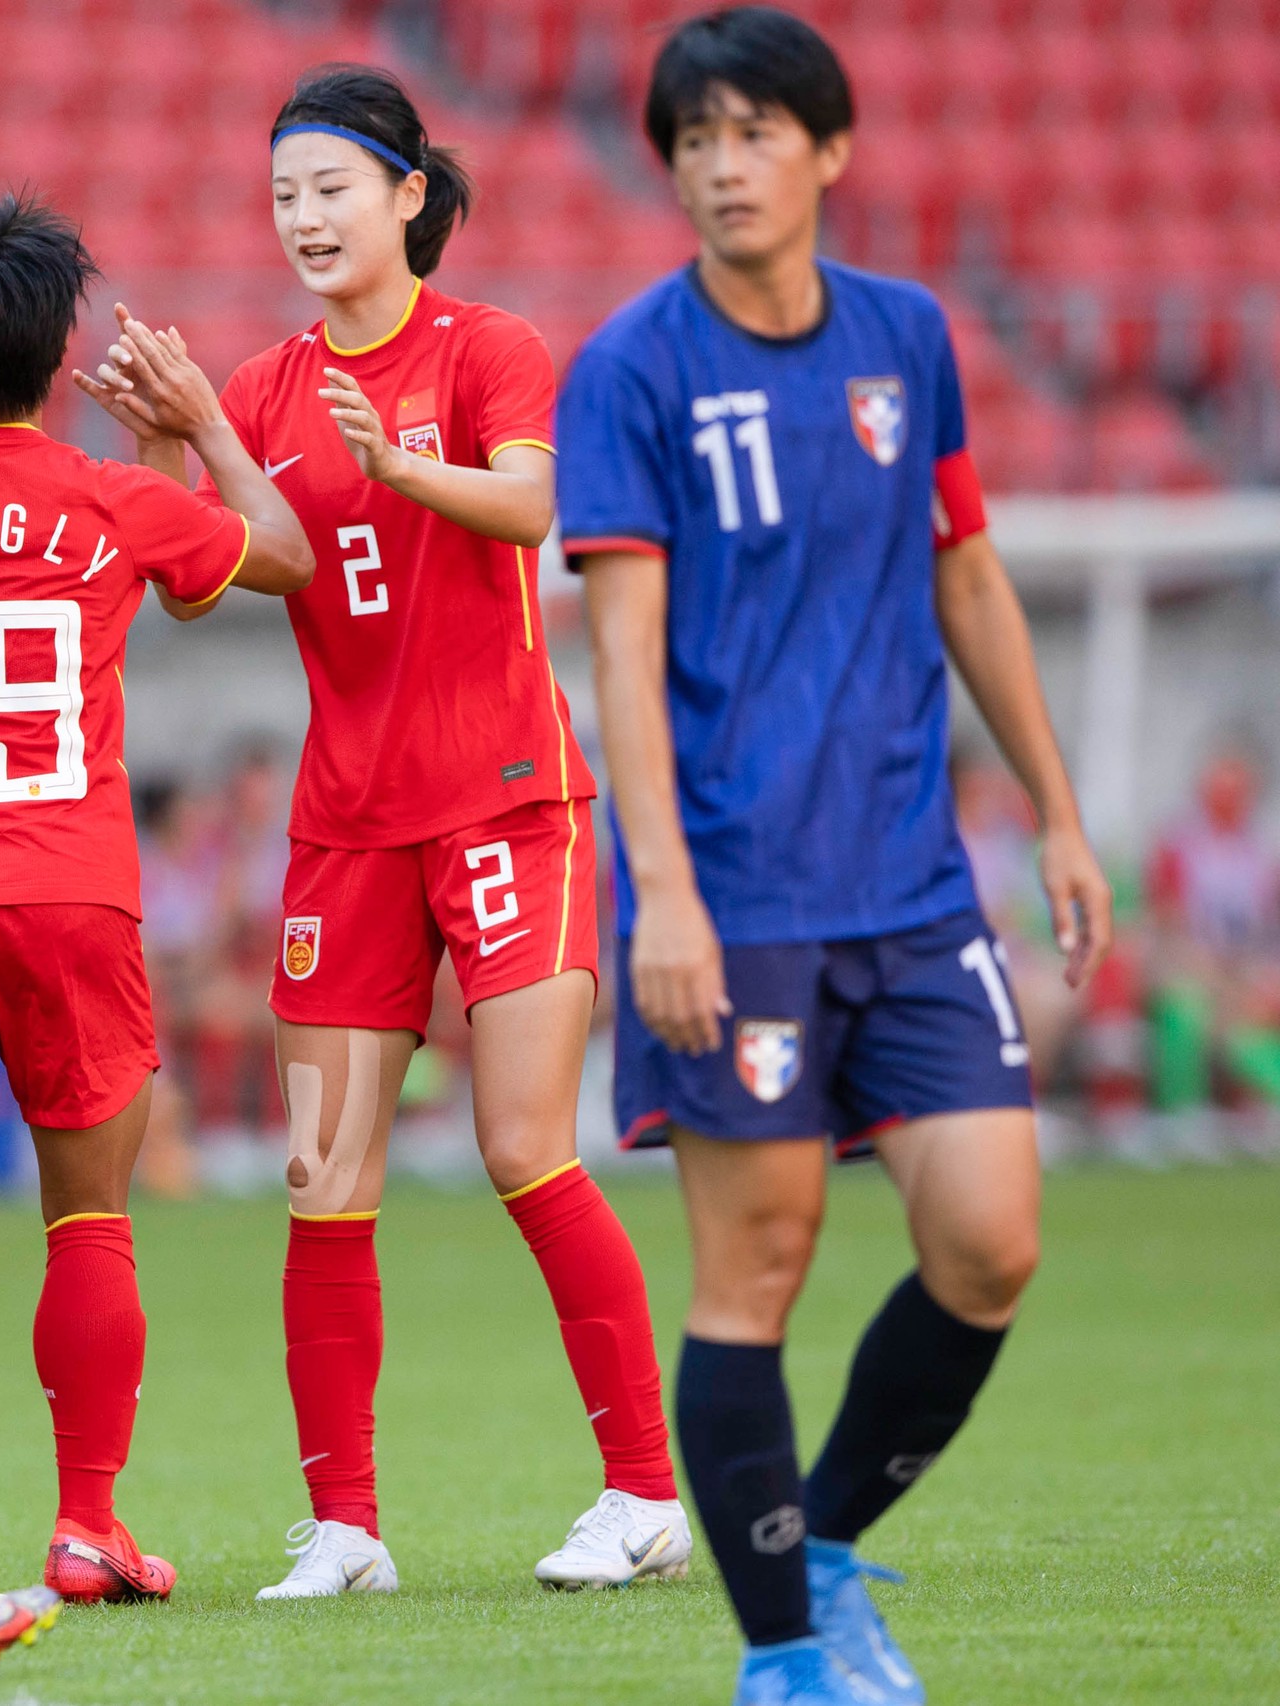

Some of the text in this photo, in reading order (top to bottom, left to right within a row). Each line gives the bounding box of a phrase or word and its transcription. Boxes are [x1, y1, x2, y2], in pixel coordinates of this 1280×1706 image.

[405, 430, 435, 447] CFA
[693, 416, 783, 532] 11
[43, 514, 68, 565] L
[81, 534, 119, 582] Y
[337, 524, 389, 616] 2
[289, 922, 316, 936] CFA
[464, 840, 519, 931] 2
[958, 936, 1018, 1041] 1
